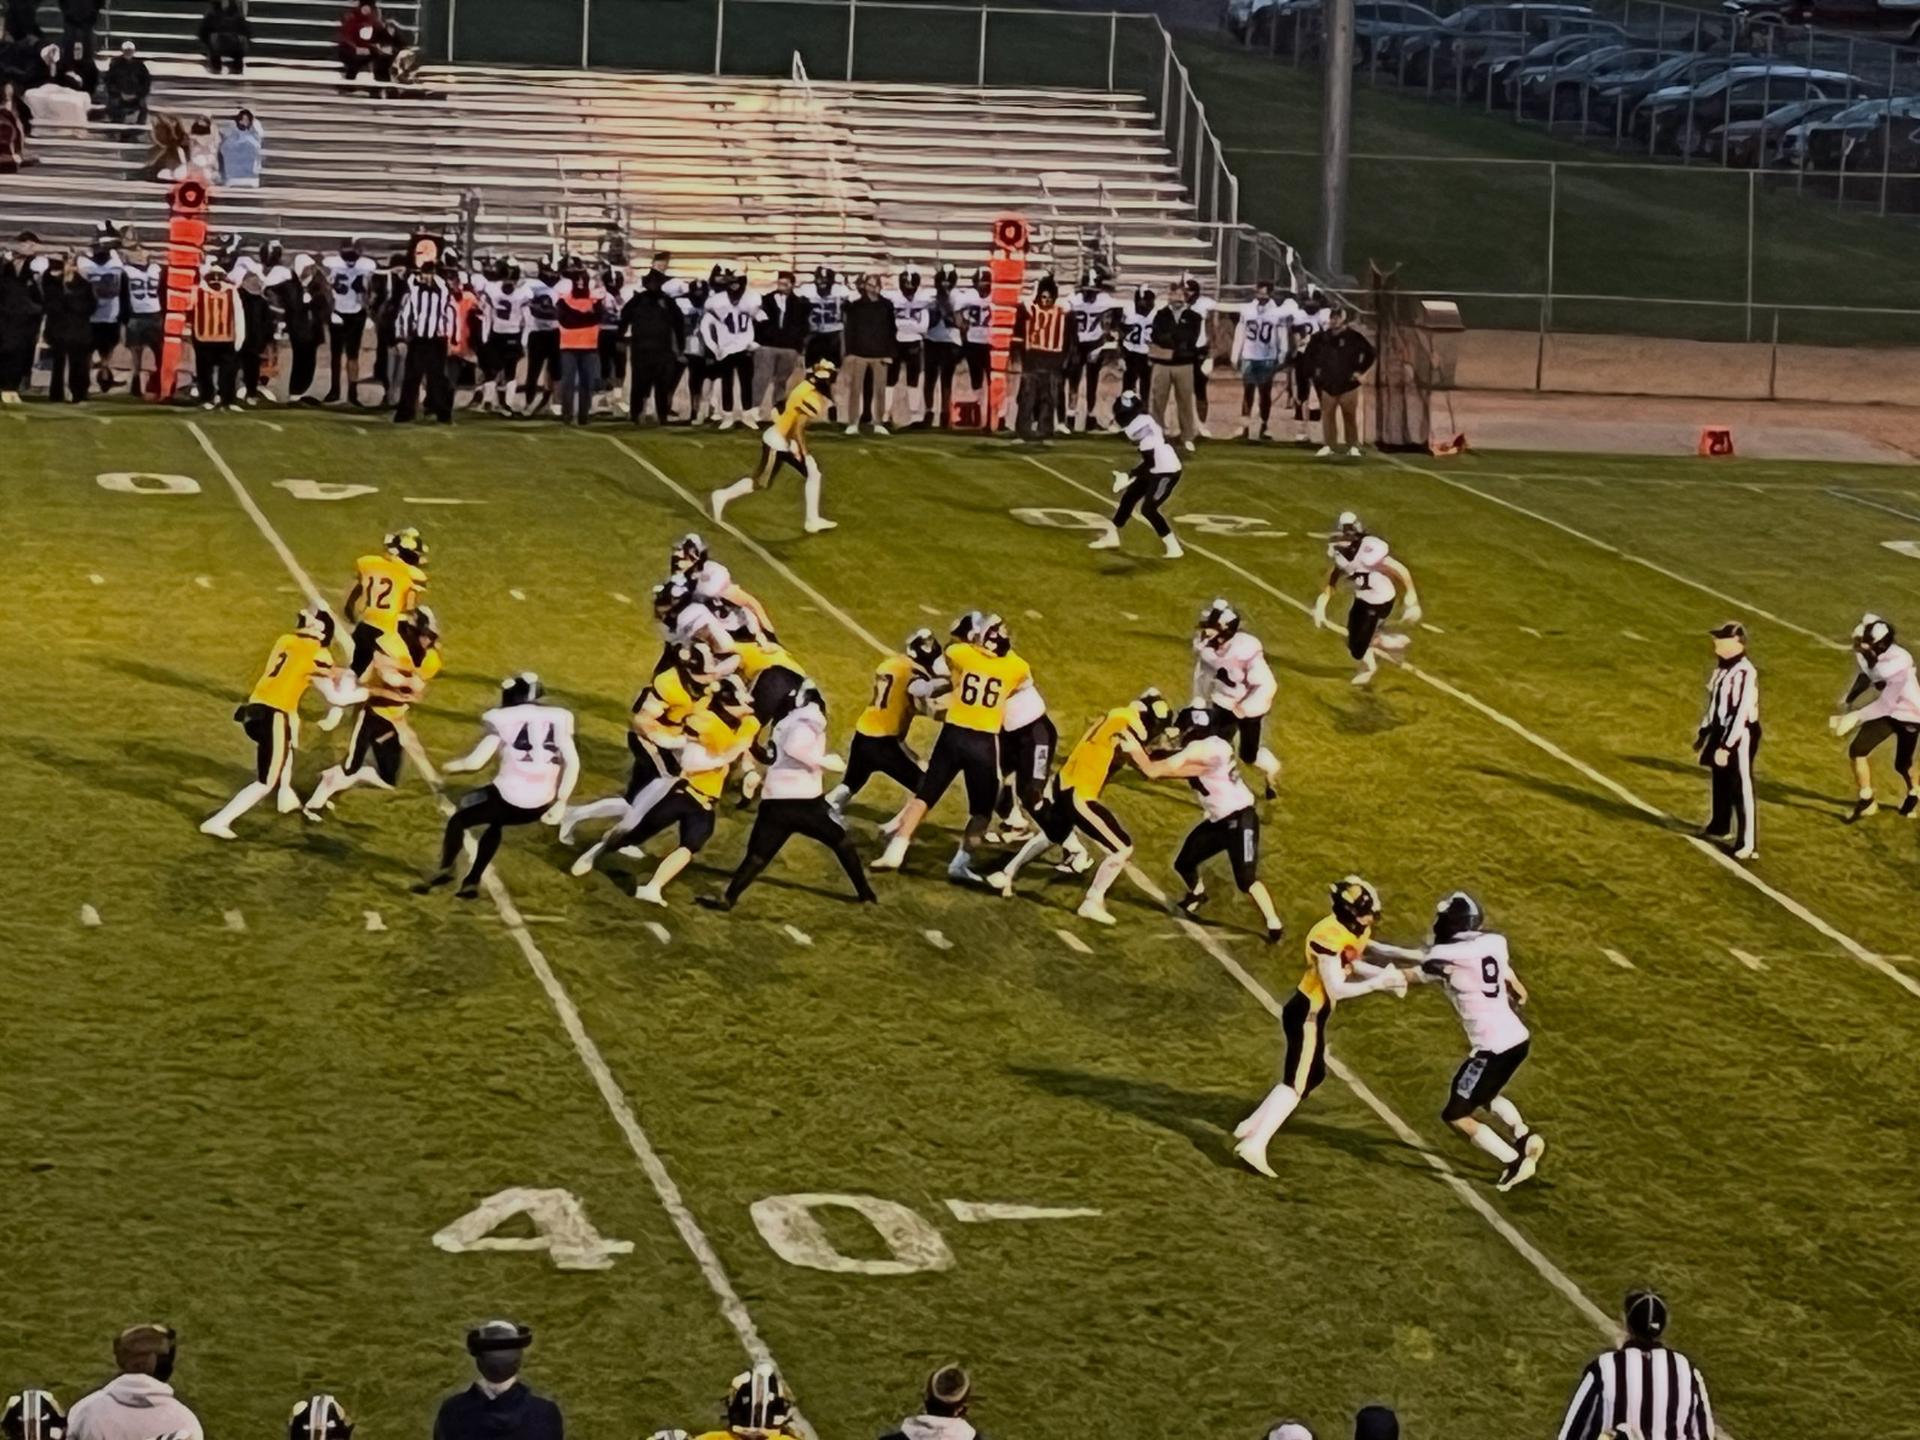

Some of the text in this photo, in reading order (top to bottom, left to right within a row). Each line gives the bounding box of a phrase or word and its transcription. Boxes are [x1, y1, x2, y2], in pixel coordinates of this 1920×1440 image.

[366, 576, 393, 610] 12
[961, 672, 1002, 709] 66
[1480, 956, 1500, 998] 9
